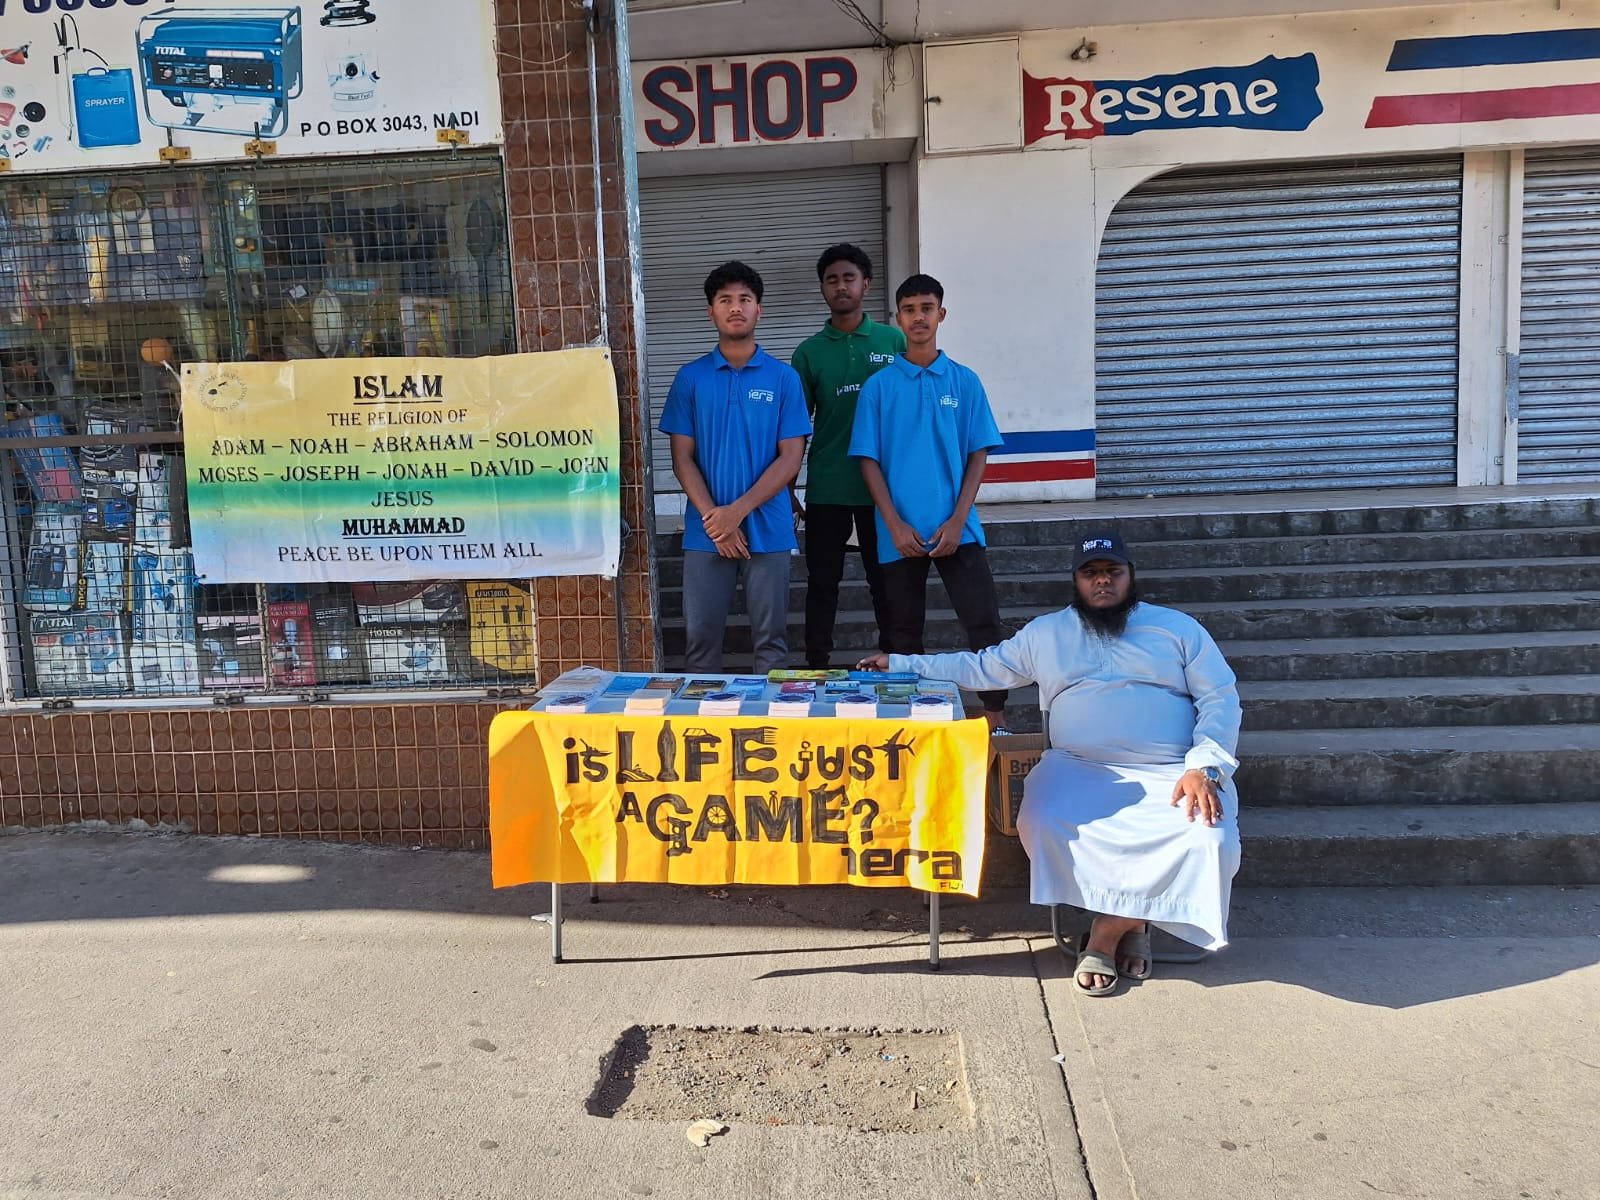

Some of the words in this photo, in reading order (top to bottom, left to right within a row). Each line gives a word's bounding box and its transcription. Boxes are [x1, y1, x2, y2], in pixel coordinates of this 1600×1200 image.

[155, 46, 187, 56] TOTAL
[84, 96, 126, 108] SPRAYER
[641, 55, 858, 147] SHOP
[1043, 78, 1279, 132] Resene
[300, 122, 312, 137] P
[317, 121, 331, 136] O
[337, 118, 378, 135] BOX
[382, 115, 428, 132] 3043,
[433, 110, 479, 129] NADI
[353, 374, 443, 400] ISLAM
[327, 412, 364, 427] THE
[367, 409, 443, 426] RELIGION
[447, 408, 468, 424] OF
[211, 438, 266, 456] ADAM
[289, 438, 349, 455] NOAH
[371, 434, 474, 453] ABRAHAM
[495, 428, 593, 449] SOLOMON
[198, 466, 259, 484] MOSES
[279, 464, 360, 482] JOSEPH
[382, 462, 448, 480] JONAH
[470, 457, 534, 478] DAVID
[558, 456, 609, 475] JOHN
[371, 490, 434, 508] JESUS
[341, 516, 466, 537] MUHAMMAD
[278, 545, 341, 563] PEACE
[347, 546, 374, 562] BE
[379, 544, 433, 562] UPON
[438, 542, 497, 560] THEM
[502, 542, 543, 559] ALL
[563, 737, 612, 784] is
[616, 720, 780, 784] LIFE
[616, 791, 645, 823] A
[646, 783, 880, 857] GAME?
